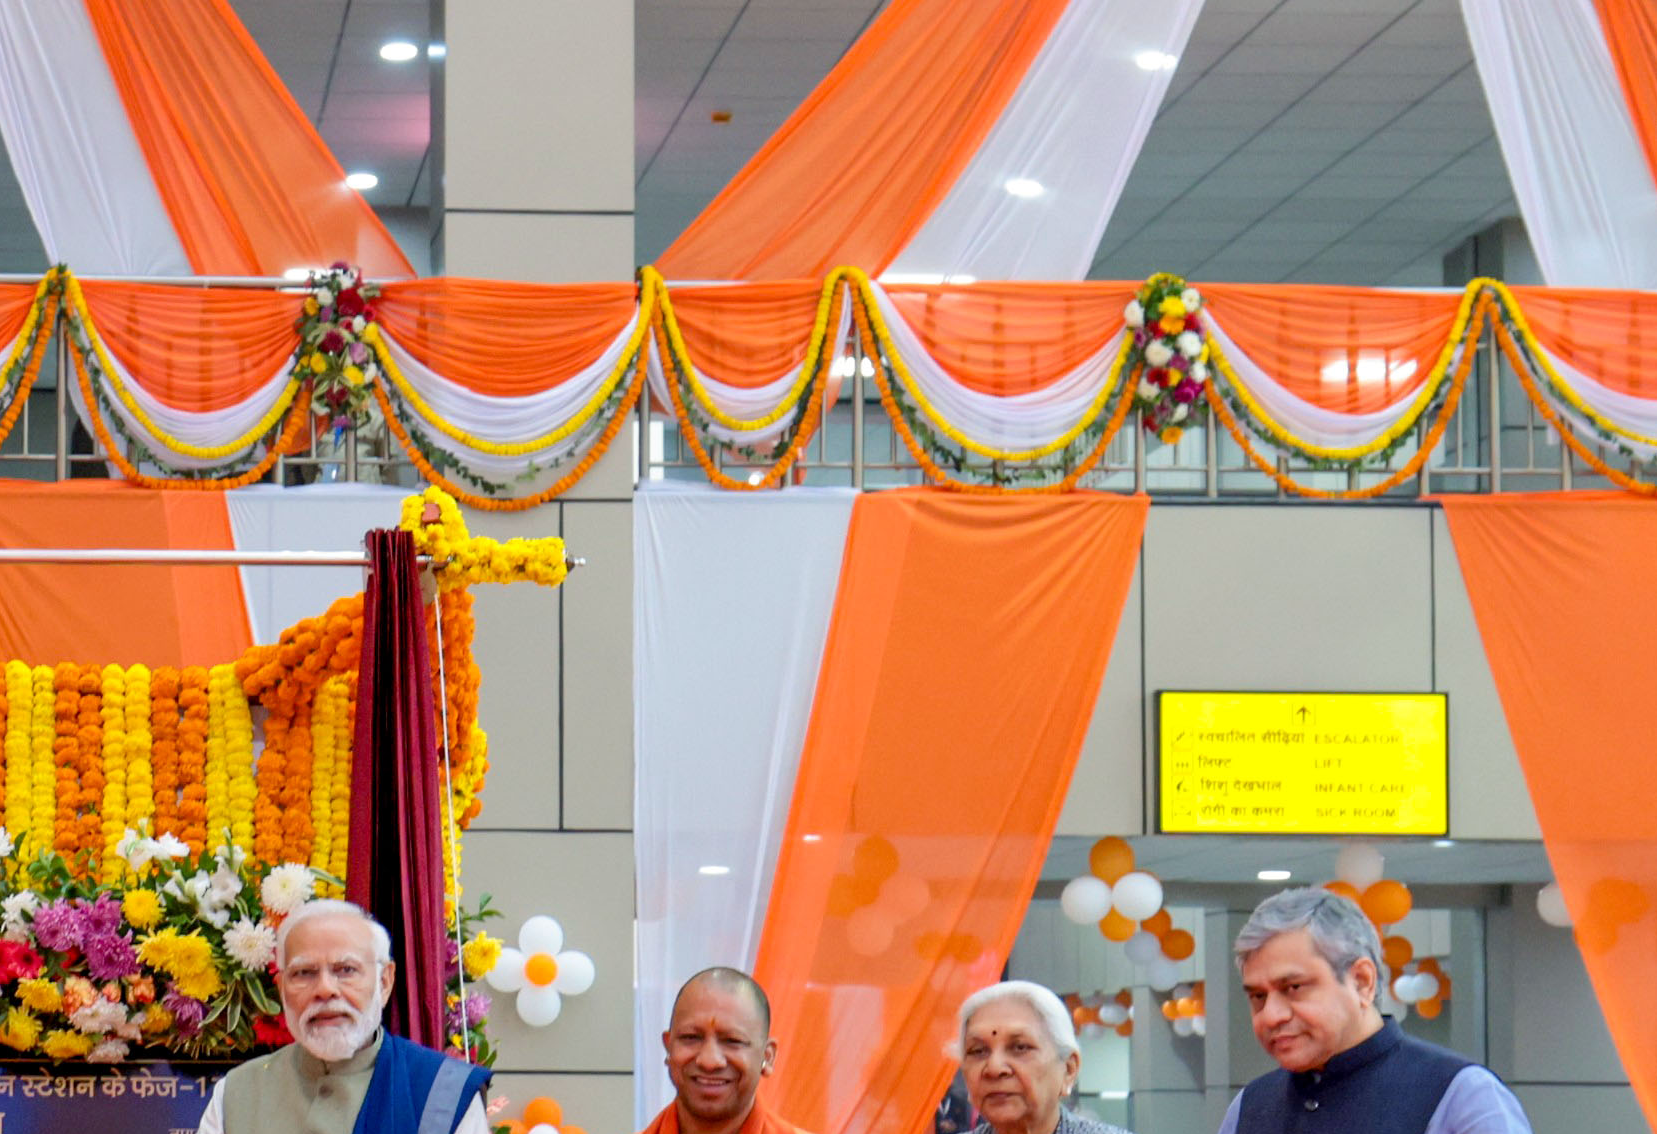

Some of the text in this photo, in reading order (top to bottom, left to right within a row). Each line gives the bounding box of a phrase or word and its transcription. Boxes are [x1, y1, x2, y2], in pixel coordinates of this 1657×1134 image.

[1314, 734, 1400, 745] ESCALATOR
[1314, 758, 1343, 769] LIFT
[1314, 783, 1364, 793] INFANT
[1315, 807, 1397, 818] SICK ROOM
[21, 1067, 95, 1099] स्टेशन
[100, 1067, 127, 1098] के
